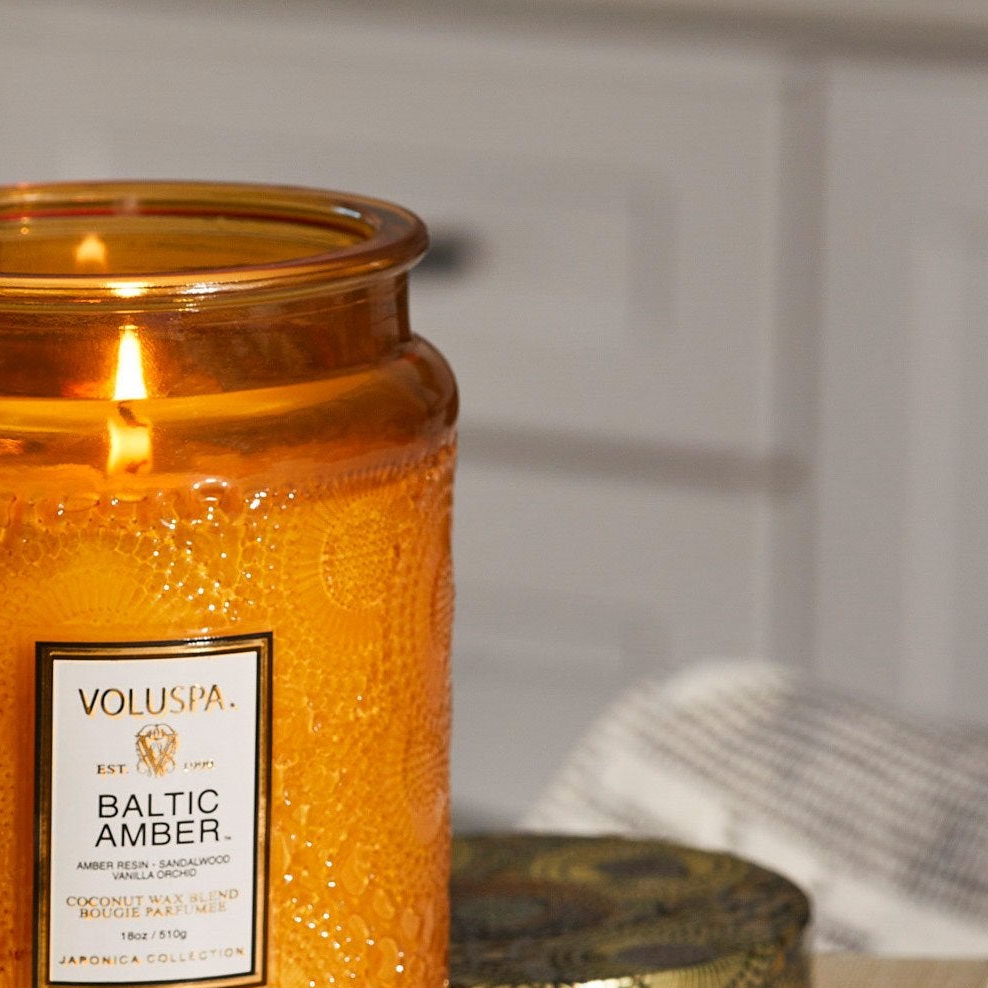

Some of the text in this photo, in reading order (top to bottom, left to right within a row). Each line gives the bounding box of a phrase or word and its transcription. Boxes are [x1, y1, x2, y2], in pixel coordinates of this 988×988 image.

[99, 789, 219, 819] BALTIC
[76, 860, 114, 870] AMBER
[117, 859, 149, 870] RESIN
[159, 855, 231, 868] SANDALWOOD
[112, 868, 197, 881] VANILLA ORCHID
[66, 888, 239, 908] COCONUT WAX BLEND
[79, 907, 140, 919] BOUGIE
[121, 931, 148, 941] 18oz
[159, 929, 187, 940] 510g
[59, 947, 245, 966] JAPONICA COLLECTION
